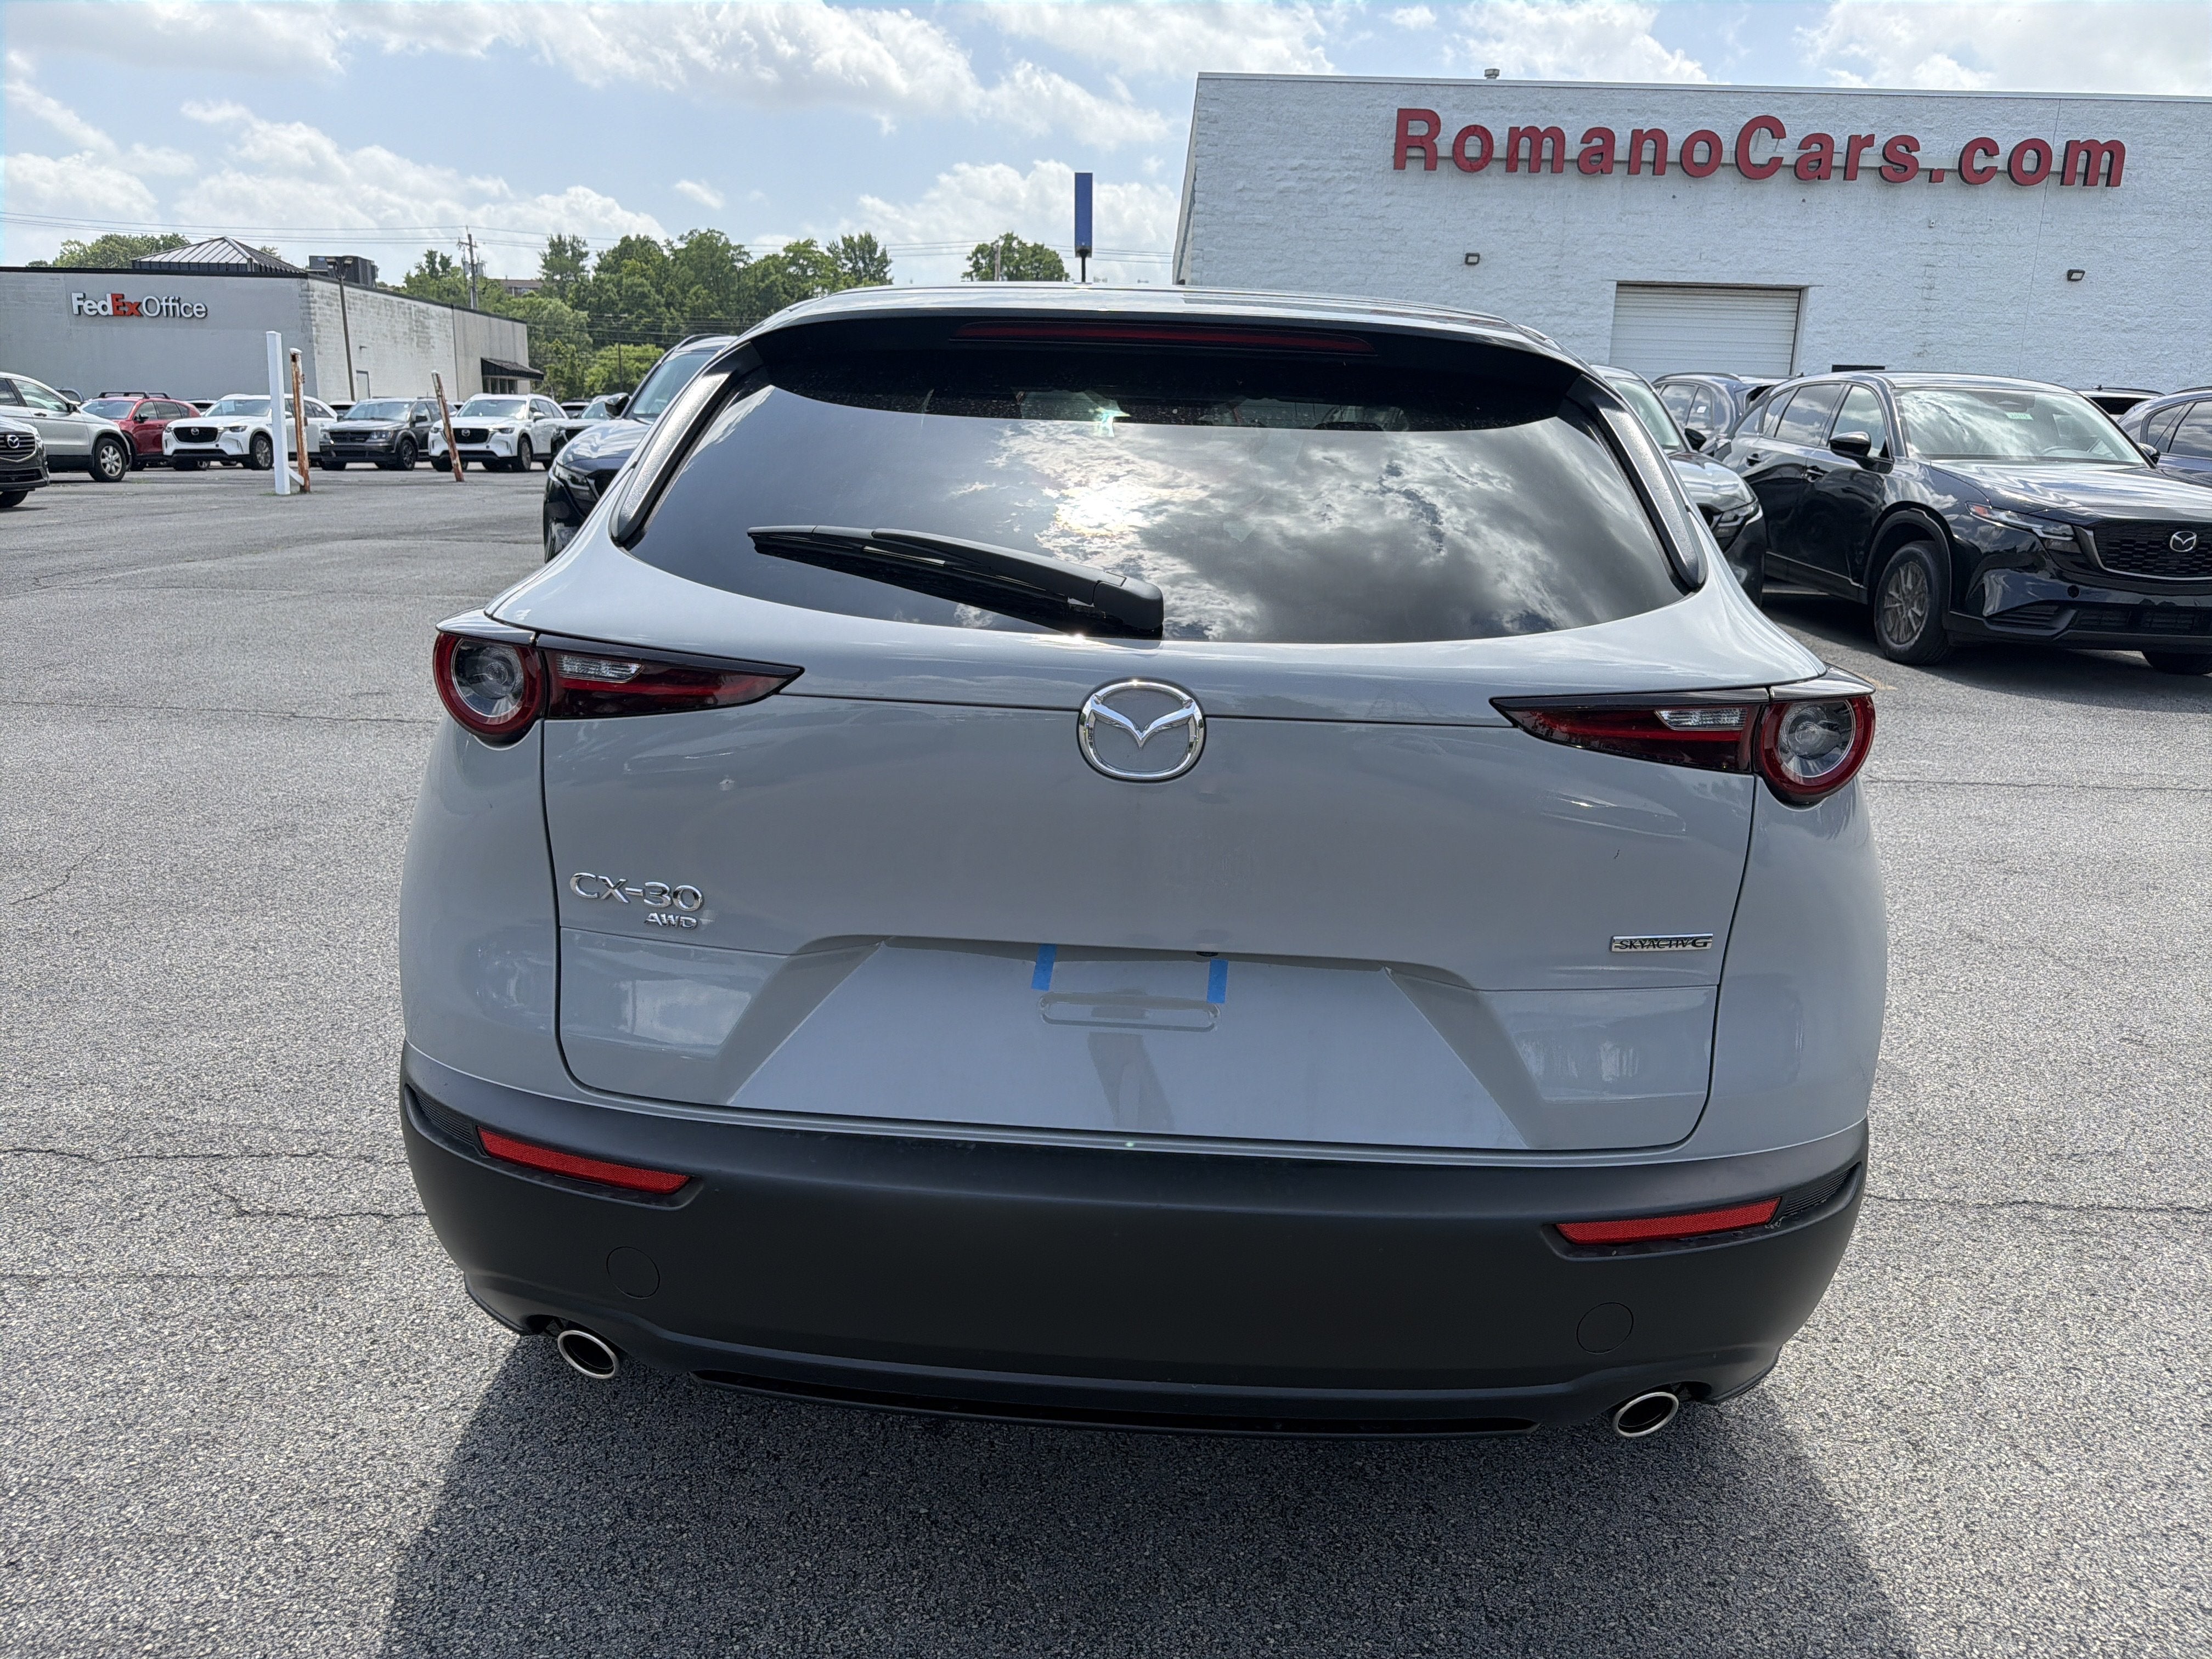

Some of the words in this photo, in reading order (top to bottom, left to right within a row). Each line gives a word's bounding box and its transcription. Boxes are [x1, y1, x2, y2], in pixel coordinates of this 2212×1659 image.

[1393, 108, 2126, 187] RomanoCars.com
[71, 292, 142, 317] FedEx
[142, 295, 208, 318] Office
[569, 872, 704, 912] CX-30
[644, 912, 698, 929] AWD
